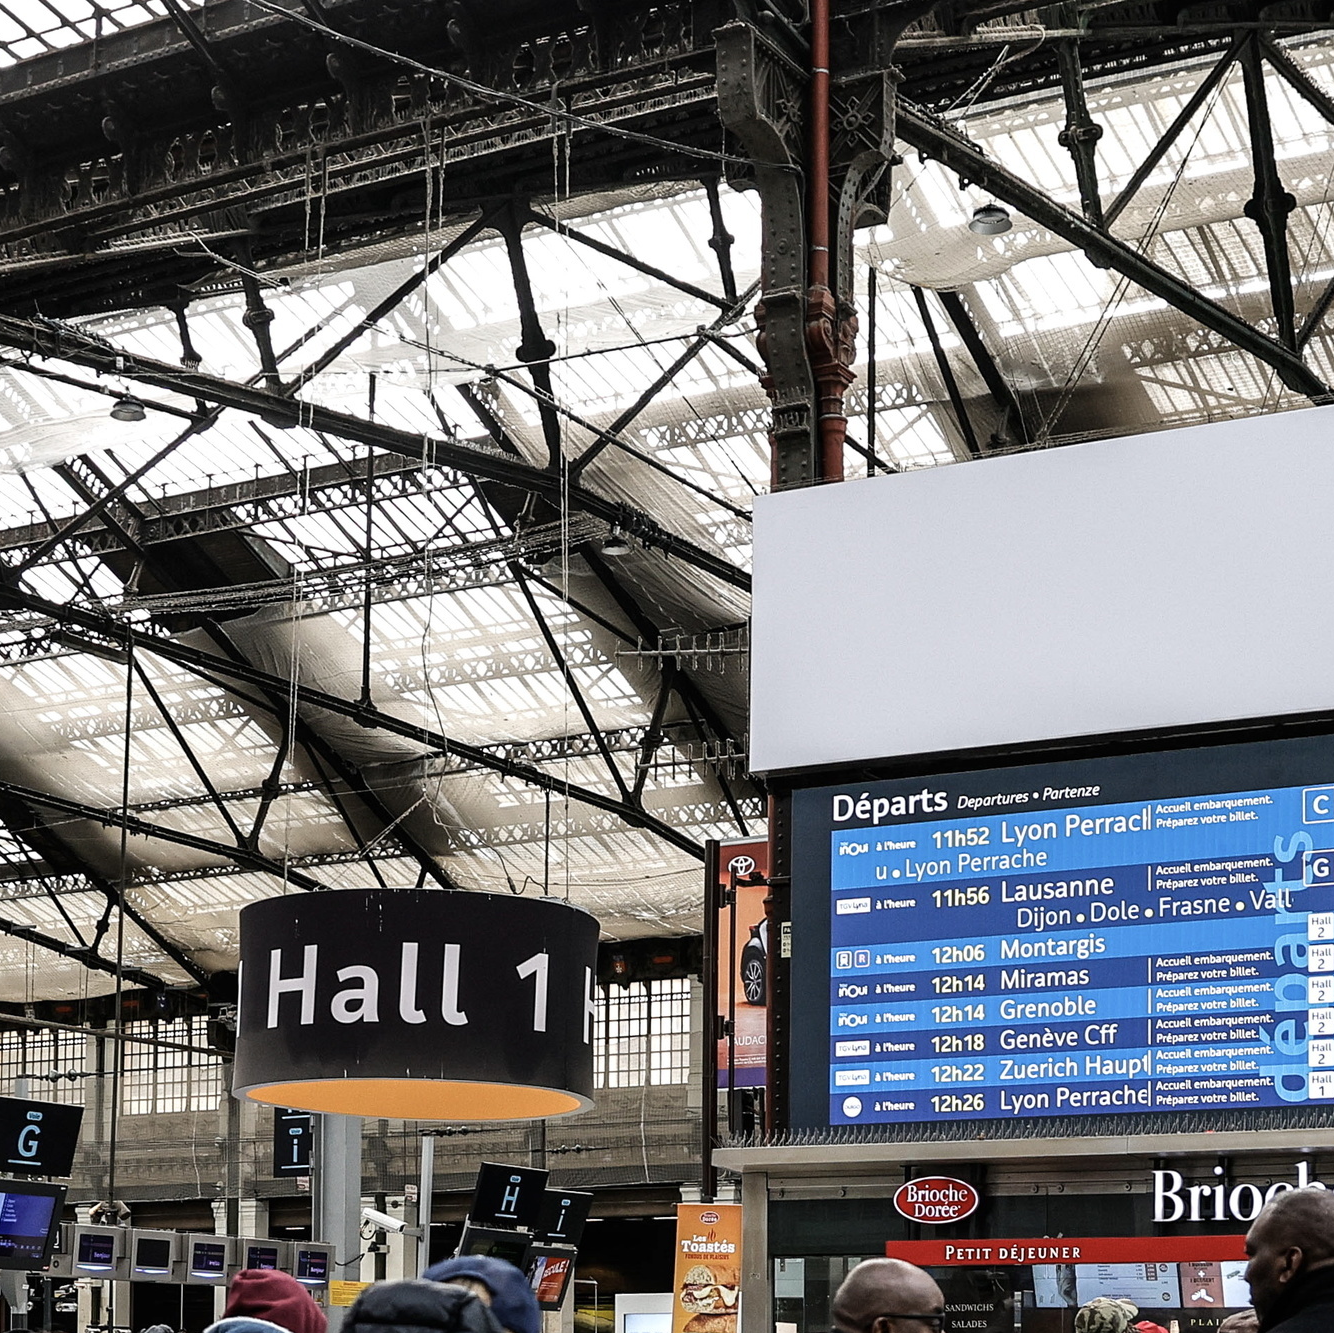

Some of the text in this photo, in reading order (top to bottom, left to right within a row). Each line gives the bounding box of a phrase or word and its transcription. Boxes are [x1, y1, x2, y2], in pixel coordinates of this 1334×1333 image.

[832, 788, 948, 824] Départs
[957, 785, 1100, 810] Departures Partenze
[1155, 795, 1273, 814] Accueil embarquement.
[1312, 795, 1329, 814] C
[1155, 811, 1258, 829] Préparez votre billet.
[876, 840, 883, 851] à
[884, 839, 916, 850] l'heure
[931, 827, 990, 849] 11h52
[1001, 820, 1057, 847] Lyon
[876, 849, 1048, 882] u Lyon Perrache
[1312, 858, 1329, 877] G
[931, 877, 1115, 909] 11h56 Lausanne
[1017, 889, 1294, 931] Dijon Dole Frasne Vall
[1311, 917, 1331, 926] Hall
[1318, 927, 1325, 938] 2
[931, 934, 1106, 964] 12h06 Montargis
[267, 942, 549, 1033] Hall 1
[931, 968, 1090, 994] 12h14 Miramas
[931, 995, 1096, 1024] 12h14 Grenoble
[931, 1023, 1119, 1053] 12h18 Genève Cff
[931, 1063, 984, 1083] 12h22
[1000, 1056, 1078, 1081] Zuerich
[931, 1084, 1148, 1114] 12h26 Lyon Perrache
[18, 1124, 41, 1157] G
[501, 1185, 520, 1212] H
[907, 1184, 968, 1204] Brioche
[914, 1202, 959, 1217] Dorée
[680, 1236, 735, 1253] Toastés
[945, 1304, 994, 1312] SANDWICHS
